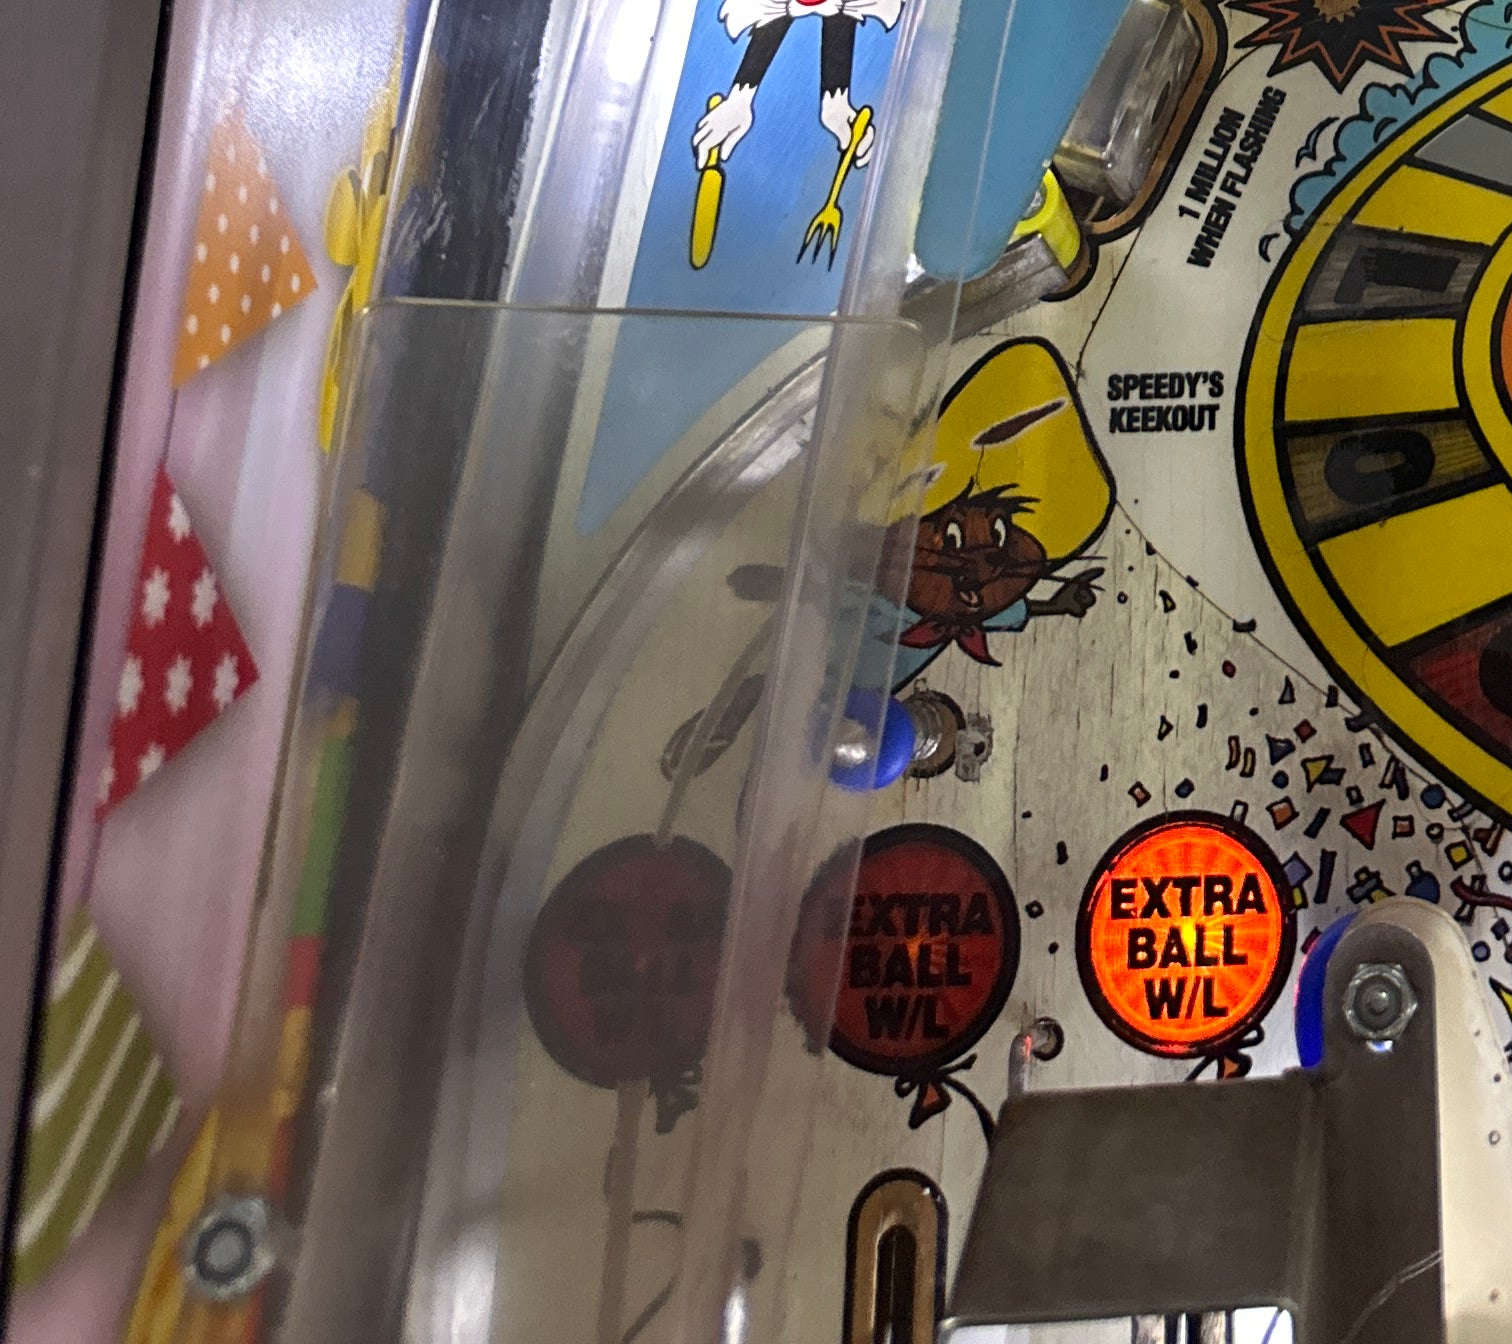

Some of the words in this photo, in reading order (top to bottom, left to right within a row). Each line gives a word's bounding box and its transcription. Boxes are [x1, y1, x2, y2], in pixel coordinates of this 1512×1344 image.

[1185, 107, 1246, 213] MILLION
[1187, 194, 1239, 269] WHEN
[1225, 85, 1288, 197] FLASHING
[1108, 404, 1220, 434] KEEKOUT
[828, 890, 996, 938] EXTRA
[1109, 873, 1267, 920] EXTRA
[848, 945, 973, 990] BALL
[1127, 926, 1249, 970] BALL
[863, 994, 952, 1042] W/L
[1143, 975, 1229, 1021] W/L
